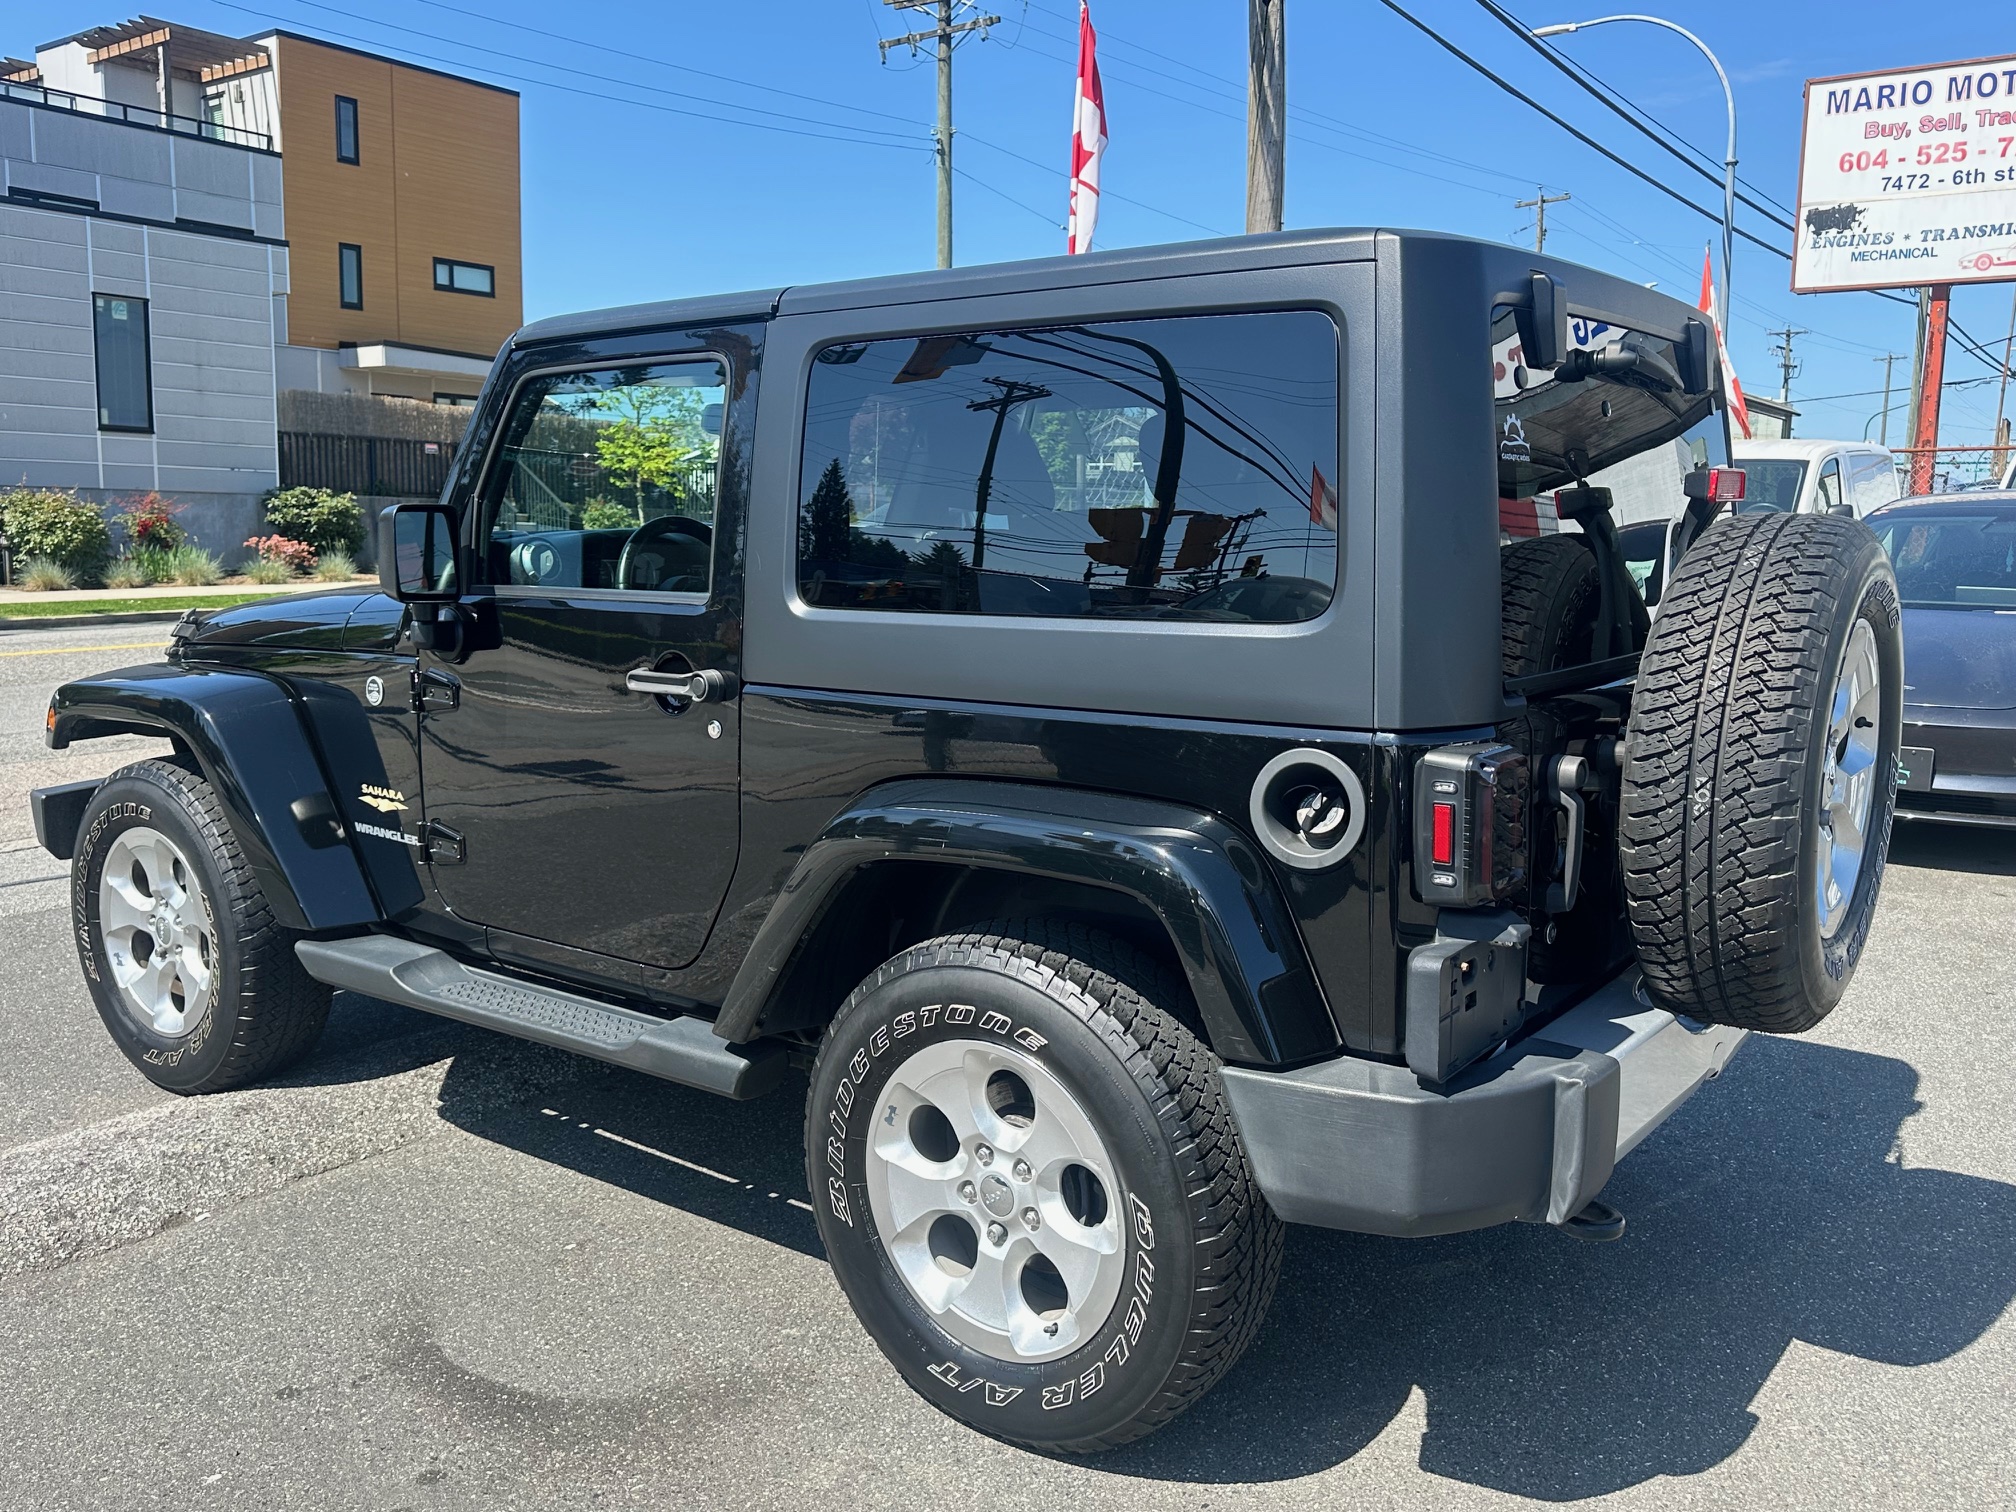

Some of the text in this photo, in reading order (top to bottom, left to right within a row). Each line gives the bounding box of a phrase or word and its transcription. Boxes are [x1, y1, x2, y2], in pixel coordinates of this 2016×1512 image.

[1826, 80, 1933, 115] MARIO
[1864, 121, 1911, 140] Buy,
[1918, 112, 1968, 133] Sell,
[1838, 148, 1888, 173] 604
[1916, 141, 1968, 166] 525
[1998, 136, 2016, 158] 7
[1882, 173, 1930, 191] 7472
[1953, 168, 1985, 185] 6th
[1811, 222, 2016, 250] ENGINES TRANSMI
[1850, 247, 1938, 262] MECHANICAL
[361, 783, 404, 801] SAHARA
[355, 821, 419, 846] WRANGLER
[76, 802, 152, 982] BRIDGESTONE
[827, 1003, 1048, 1228] BRIDGESTONE
[1042, 1192, 1155, 1410] DUELER
[926, 1361, 1025, 1406] A/T
